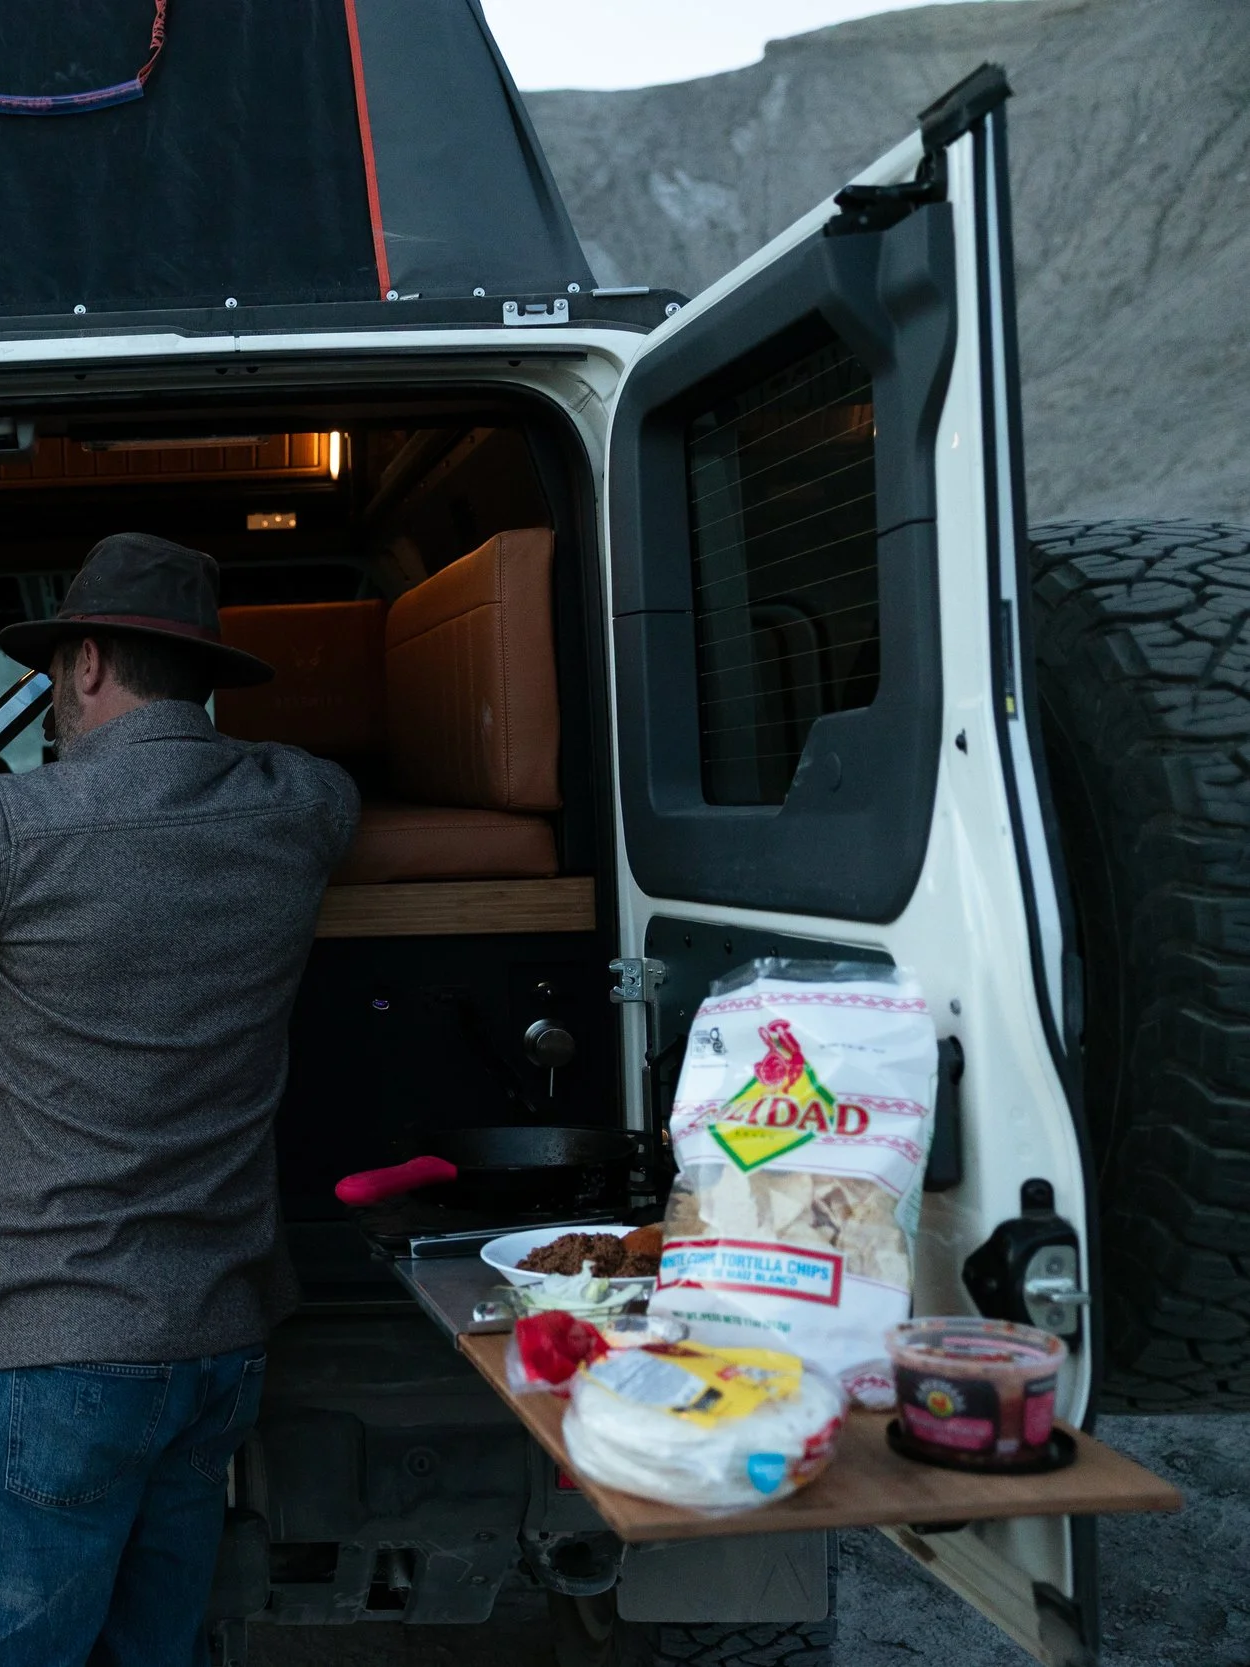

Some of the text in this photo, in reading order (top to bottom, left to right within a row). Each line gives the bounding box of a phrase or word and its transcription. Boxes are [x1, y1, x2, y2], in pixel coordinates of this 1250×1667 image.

[722, 1252, 783, 1272] TORTILLA
[788, 1259, 829, 1281] CHIPS
[756, 1273, 798, 1286] BLANCO
